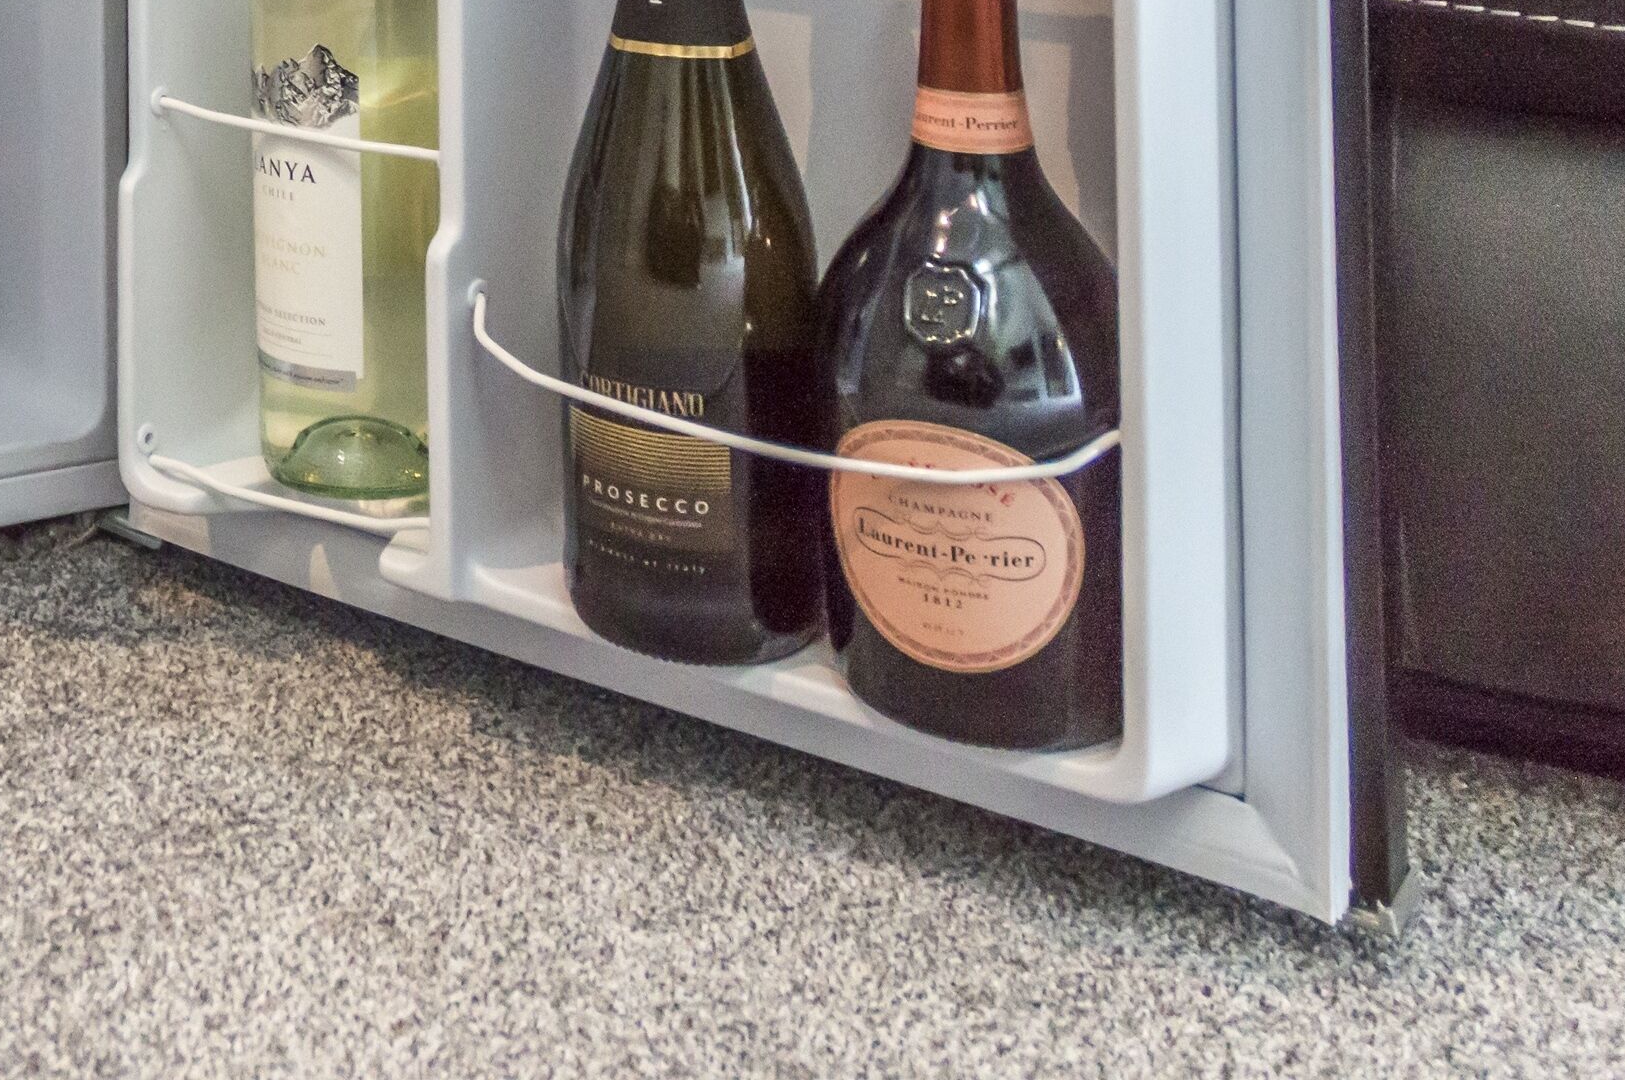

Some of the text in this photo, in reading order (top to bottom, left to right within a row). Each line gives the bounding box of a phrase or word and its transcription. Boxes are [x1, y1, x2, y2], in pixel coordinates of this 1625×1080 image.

[274, 308, 327, 327] SELECTION
[581, 373, 706, 418] CORTIGIANO
[582, 473, 710, 515] PROSECCO
[887, 494, 994, 522] CHAMPAGNE
[857, 517, 1035, 569] Laurent-Perier
[922, 593, 964, 610] 1812
